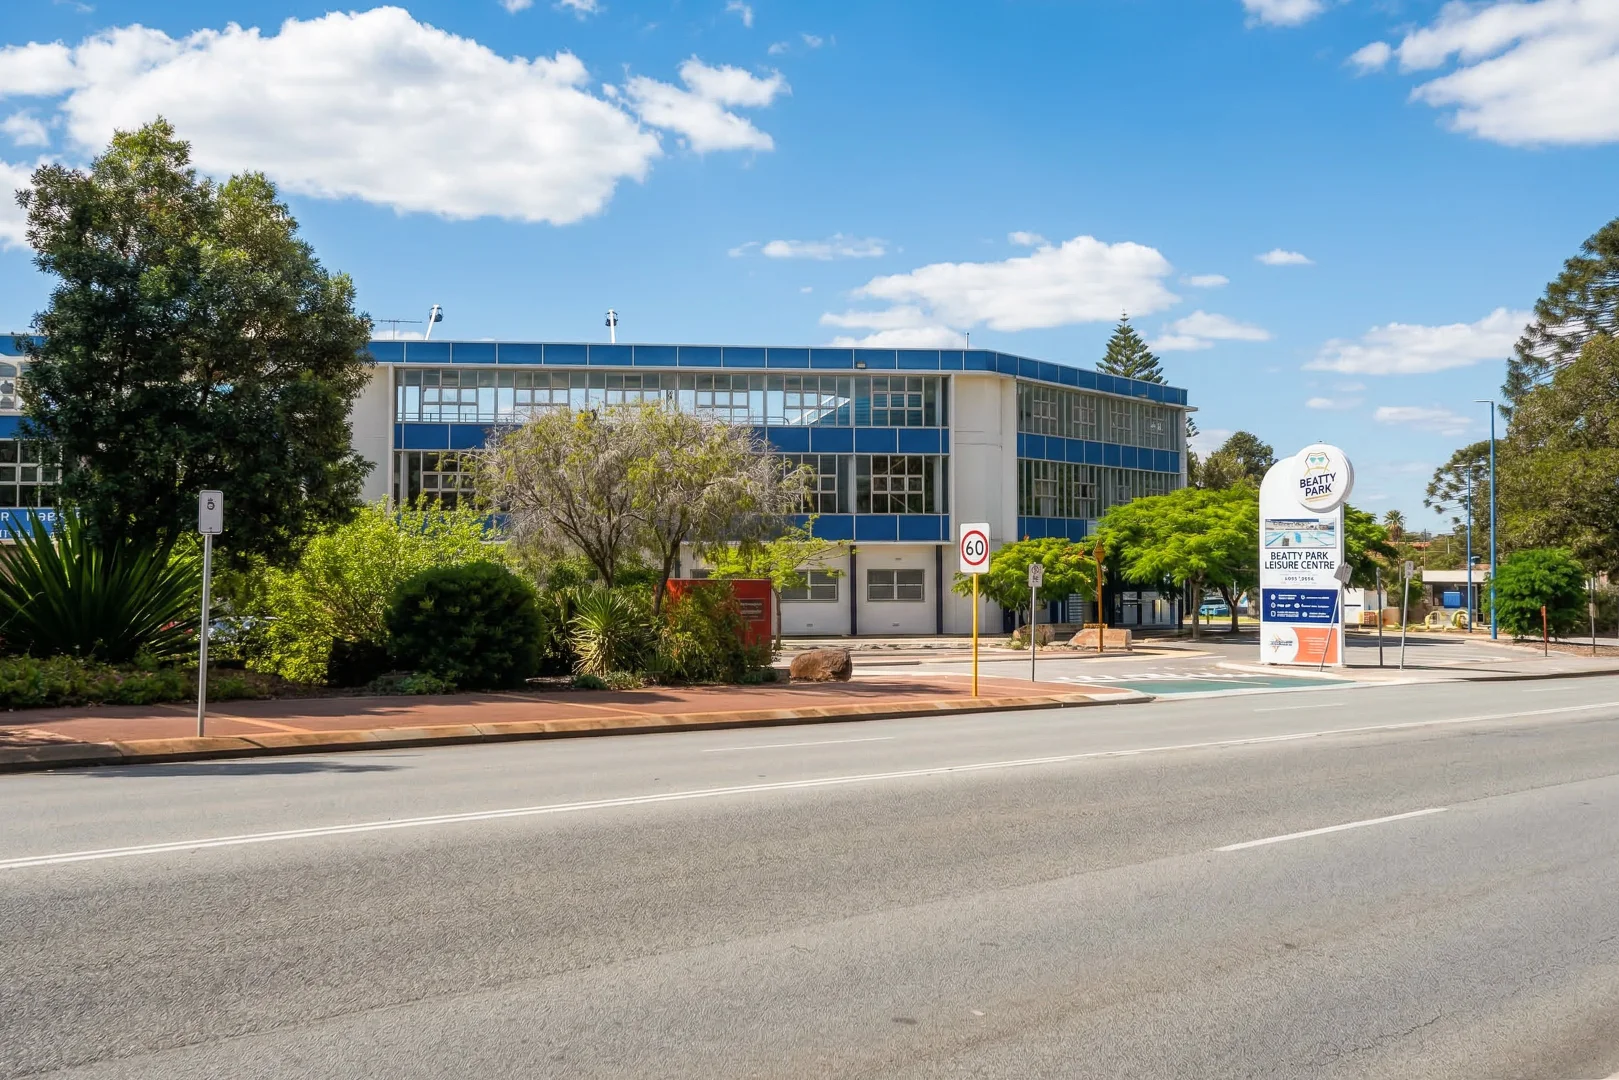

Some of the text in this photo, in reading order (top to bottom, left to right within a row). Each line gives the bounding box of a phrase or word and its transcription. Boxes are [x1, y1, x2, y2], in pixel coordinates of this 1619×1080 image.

[1300, 472, 1336, 488] BEATTY
[1305, 483, 1332, 496] PARK
[966, 540, 984, 556] 60
[1271, 552, 1328, 560] BEATTY PARK
[1265, 561, 1335, 569] LEISURE CENTRE
